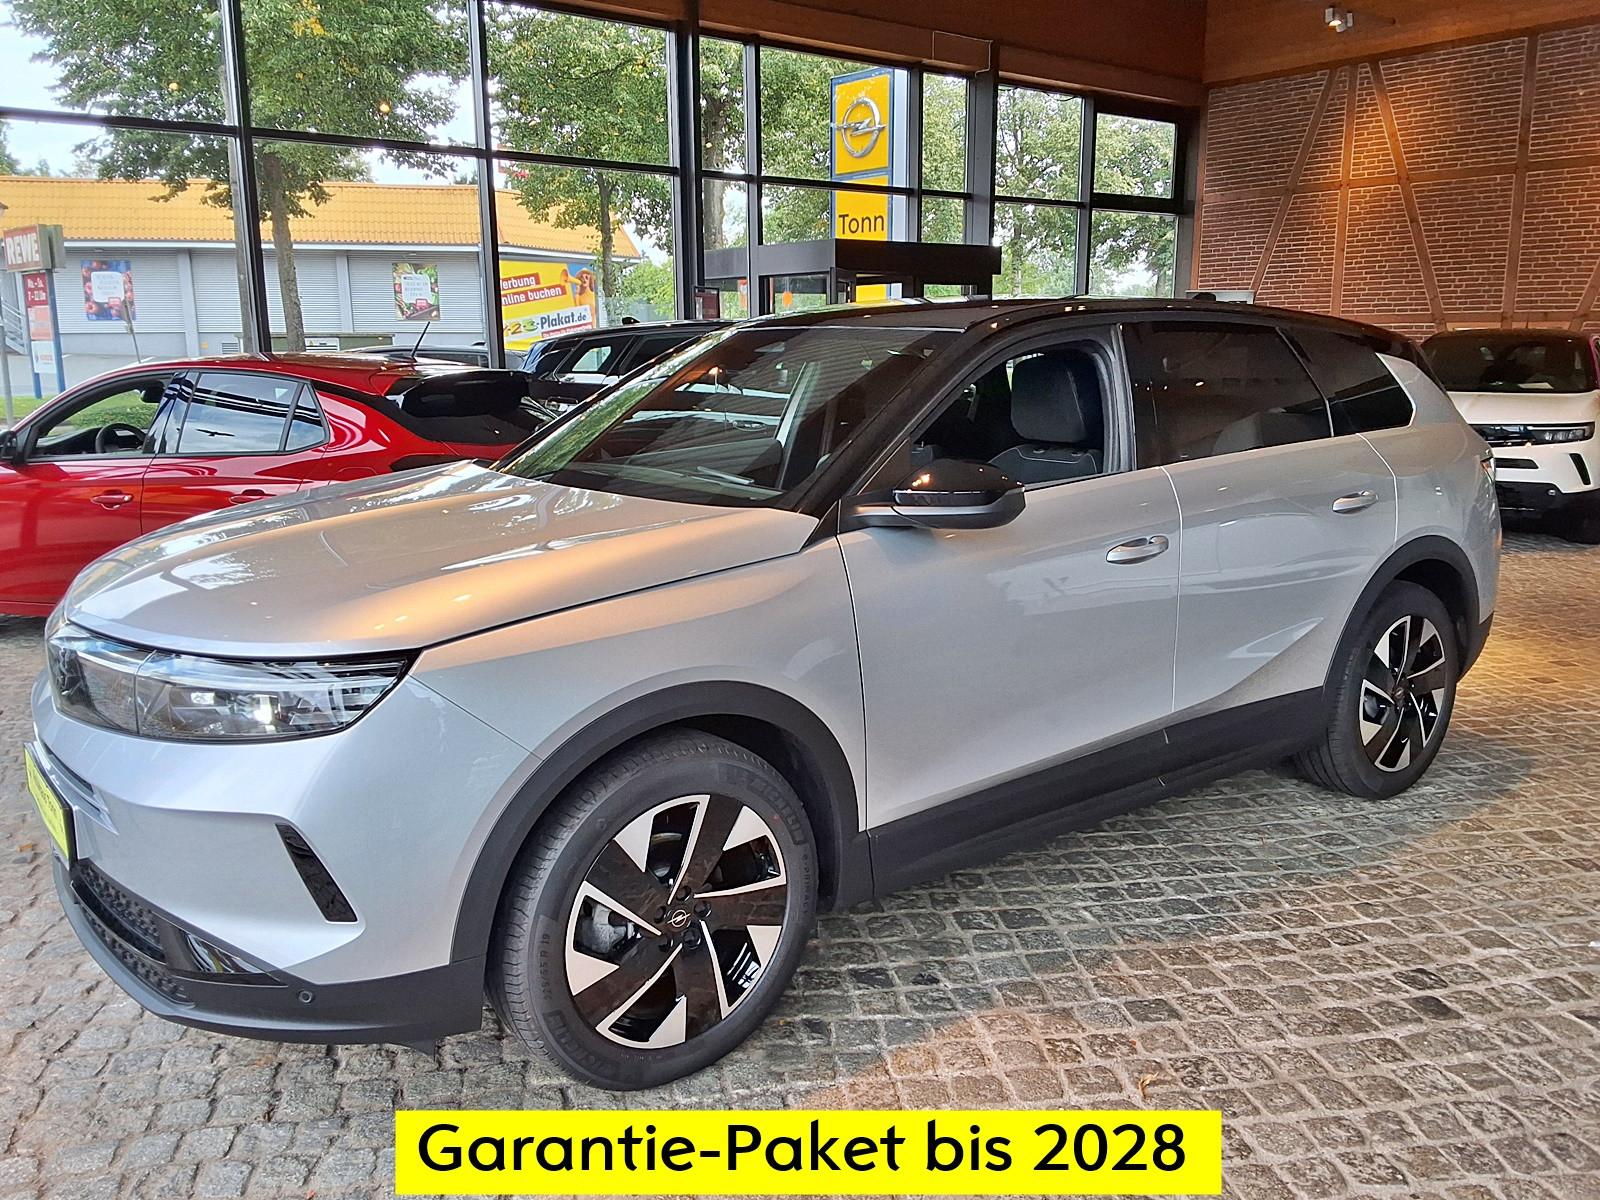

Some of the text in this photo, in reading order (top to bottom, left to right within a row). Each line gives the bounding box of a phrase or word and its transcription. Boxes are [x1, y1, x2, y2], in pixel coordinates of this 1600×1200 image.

[838, 214, 885, 235] Tonn
[6, 232, 40, 265] REWE
[500, 276, 535, 290] erbung
[501, 287, 562, 305] nline buchen
